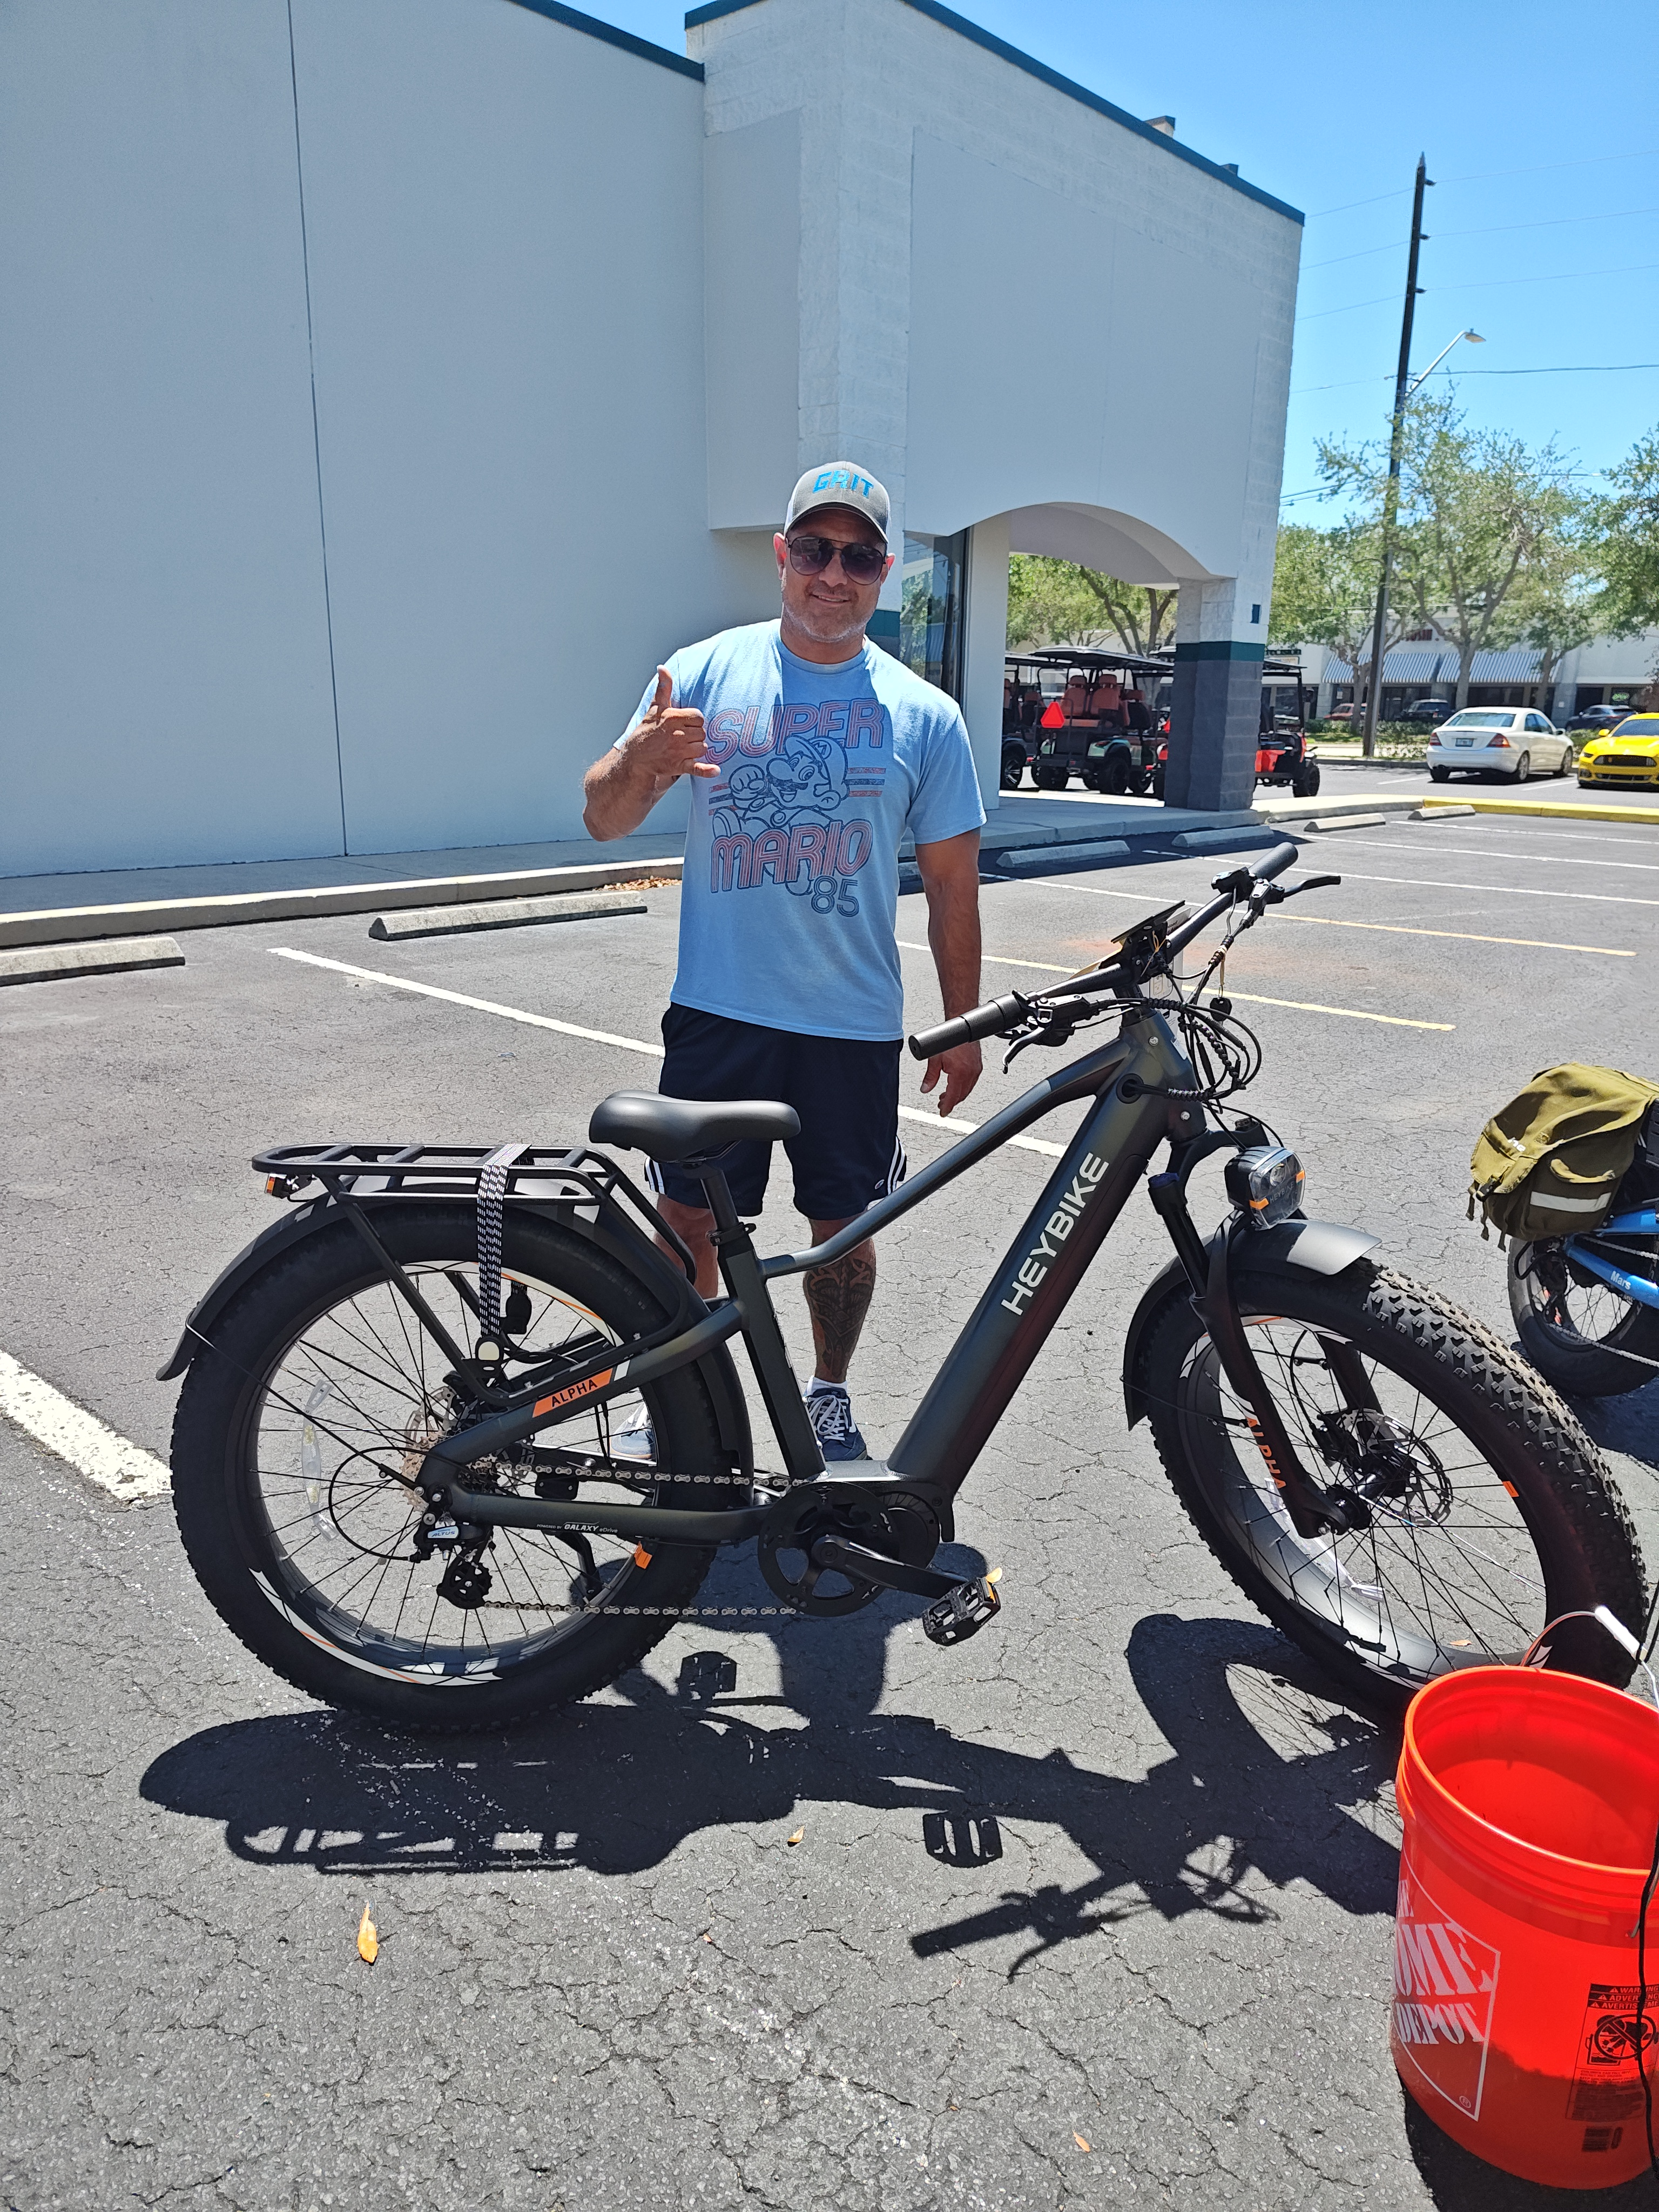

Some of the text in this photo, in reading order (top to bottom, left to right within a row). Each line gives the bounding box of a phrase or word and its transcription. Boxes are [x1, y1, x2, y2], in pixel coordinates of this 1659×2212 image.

[812, 470, 874, 498] GRIT
[706, 698, 885, 764] SUPER
[711, 819, 873, 893] MARIO
[811, 875, 860, 918] 85
[1269, 1181, 1295, 1204] HEYBIKE
[1001, 1152, 1109, 1316] HEYBIKE
[1610, 1270, 1631, 1290] Mars
[551, 1379, 598, 1407] ALPHA
[1394, 1923, 1494, 1996] OME
[1395, 2002, 1486, 2045] DEPOT
